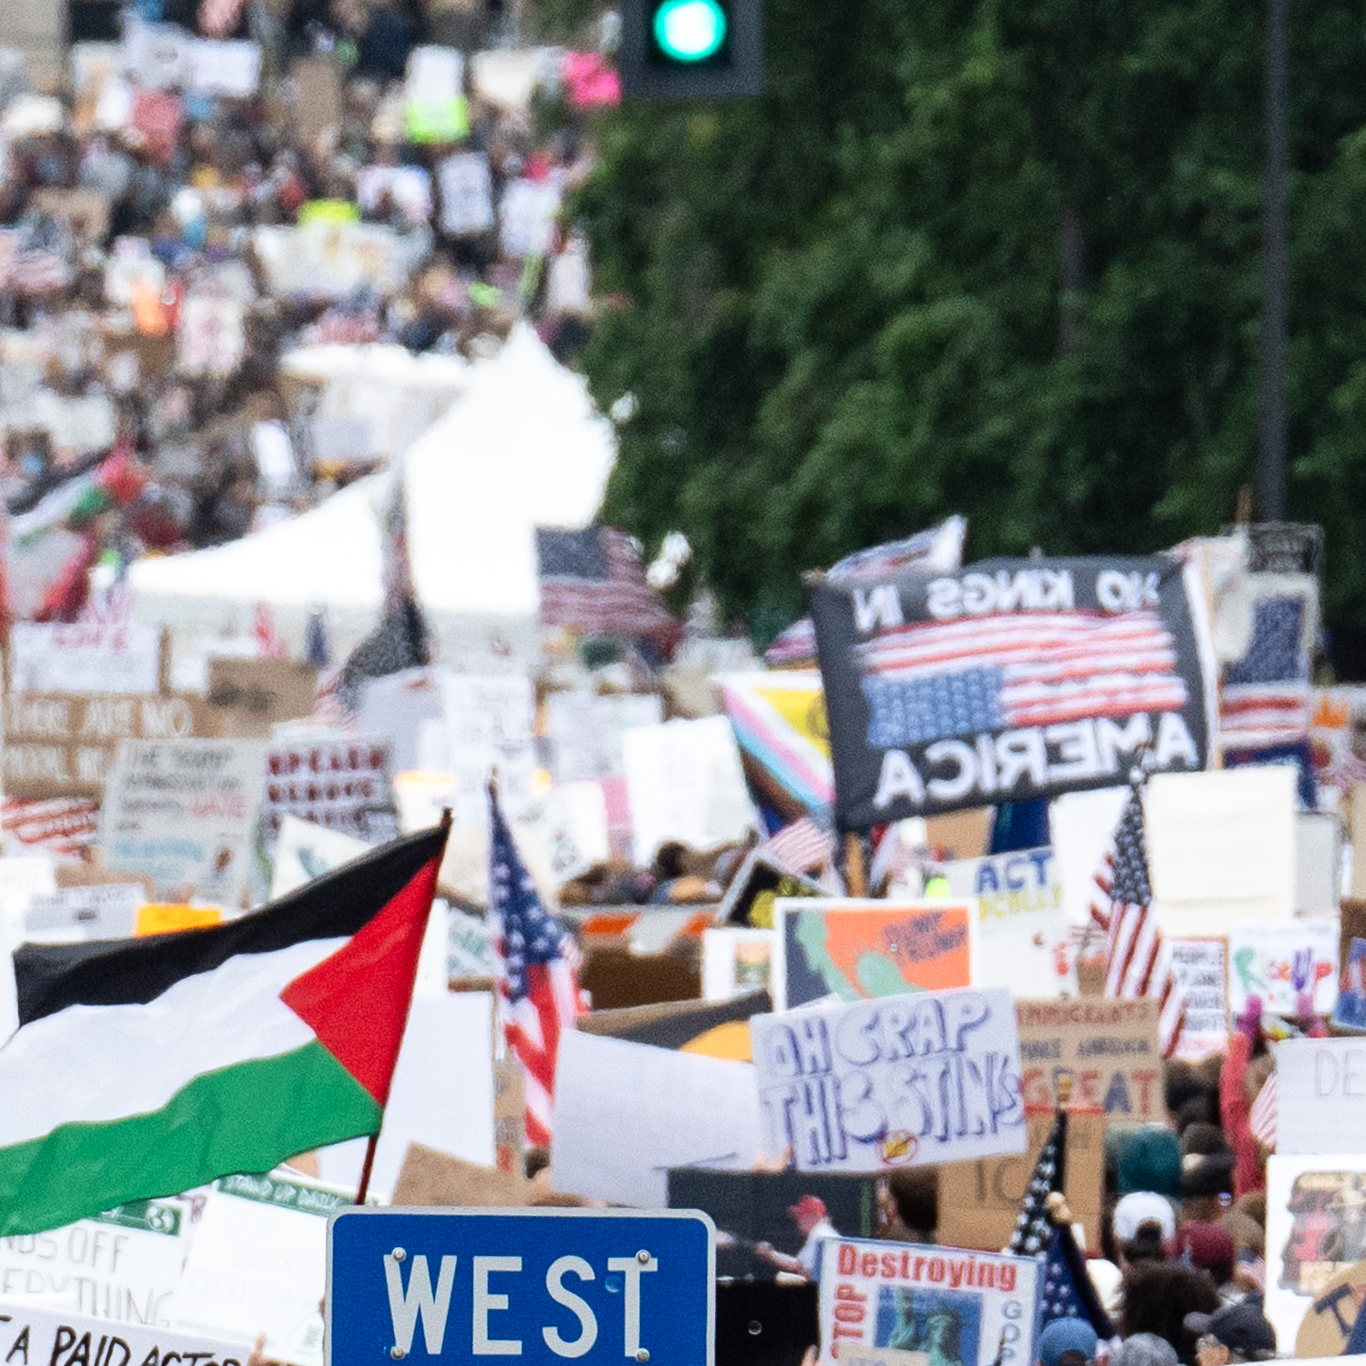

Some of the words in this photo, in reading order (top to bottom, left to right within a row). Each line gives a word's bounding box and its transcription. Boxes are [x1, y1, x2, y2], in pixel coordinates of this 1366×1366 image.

[837, 1244, 1018, 1293] Destroying
[383, 1254, 658, 1359] WEST
[5, 1324, 31, 1366] A
